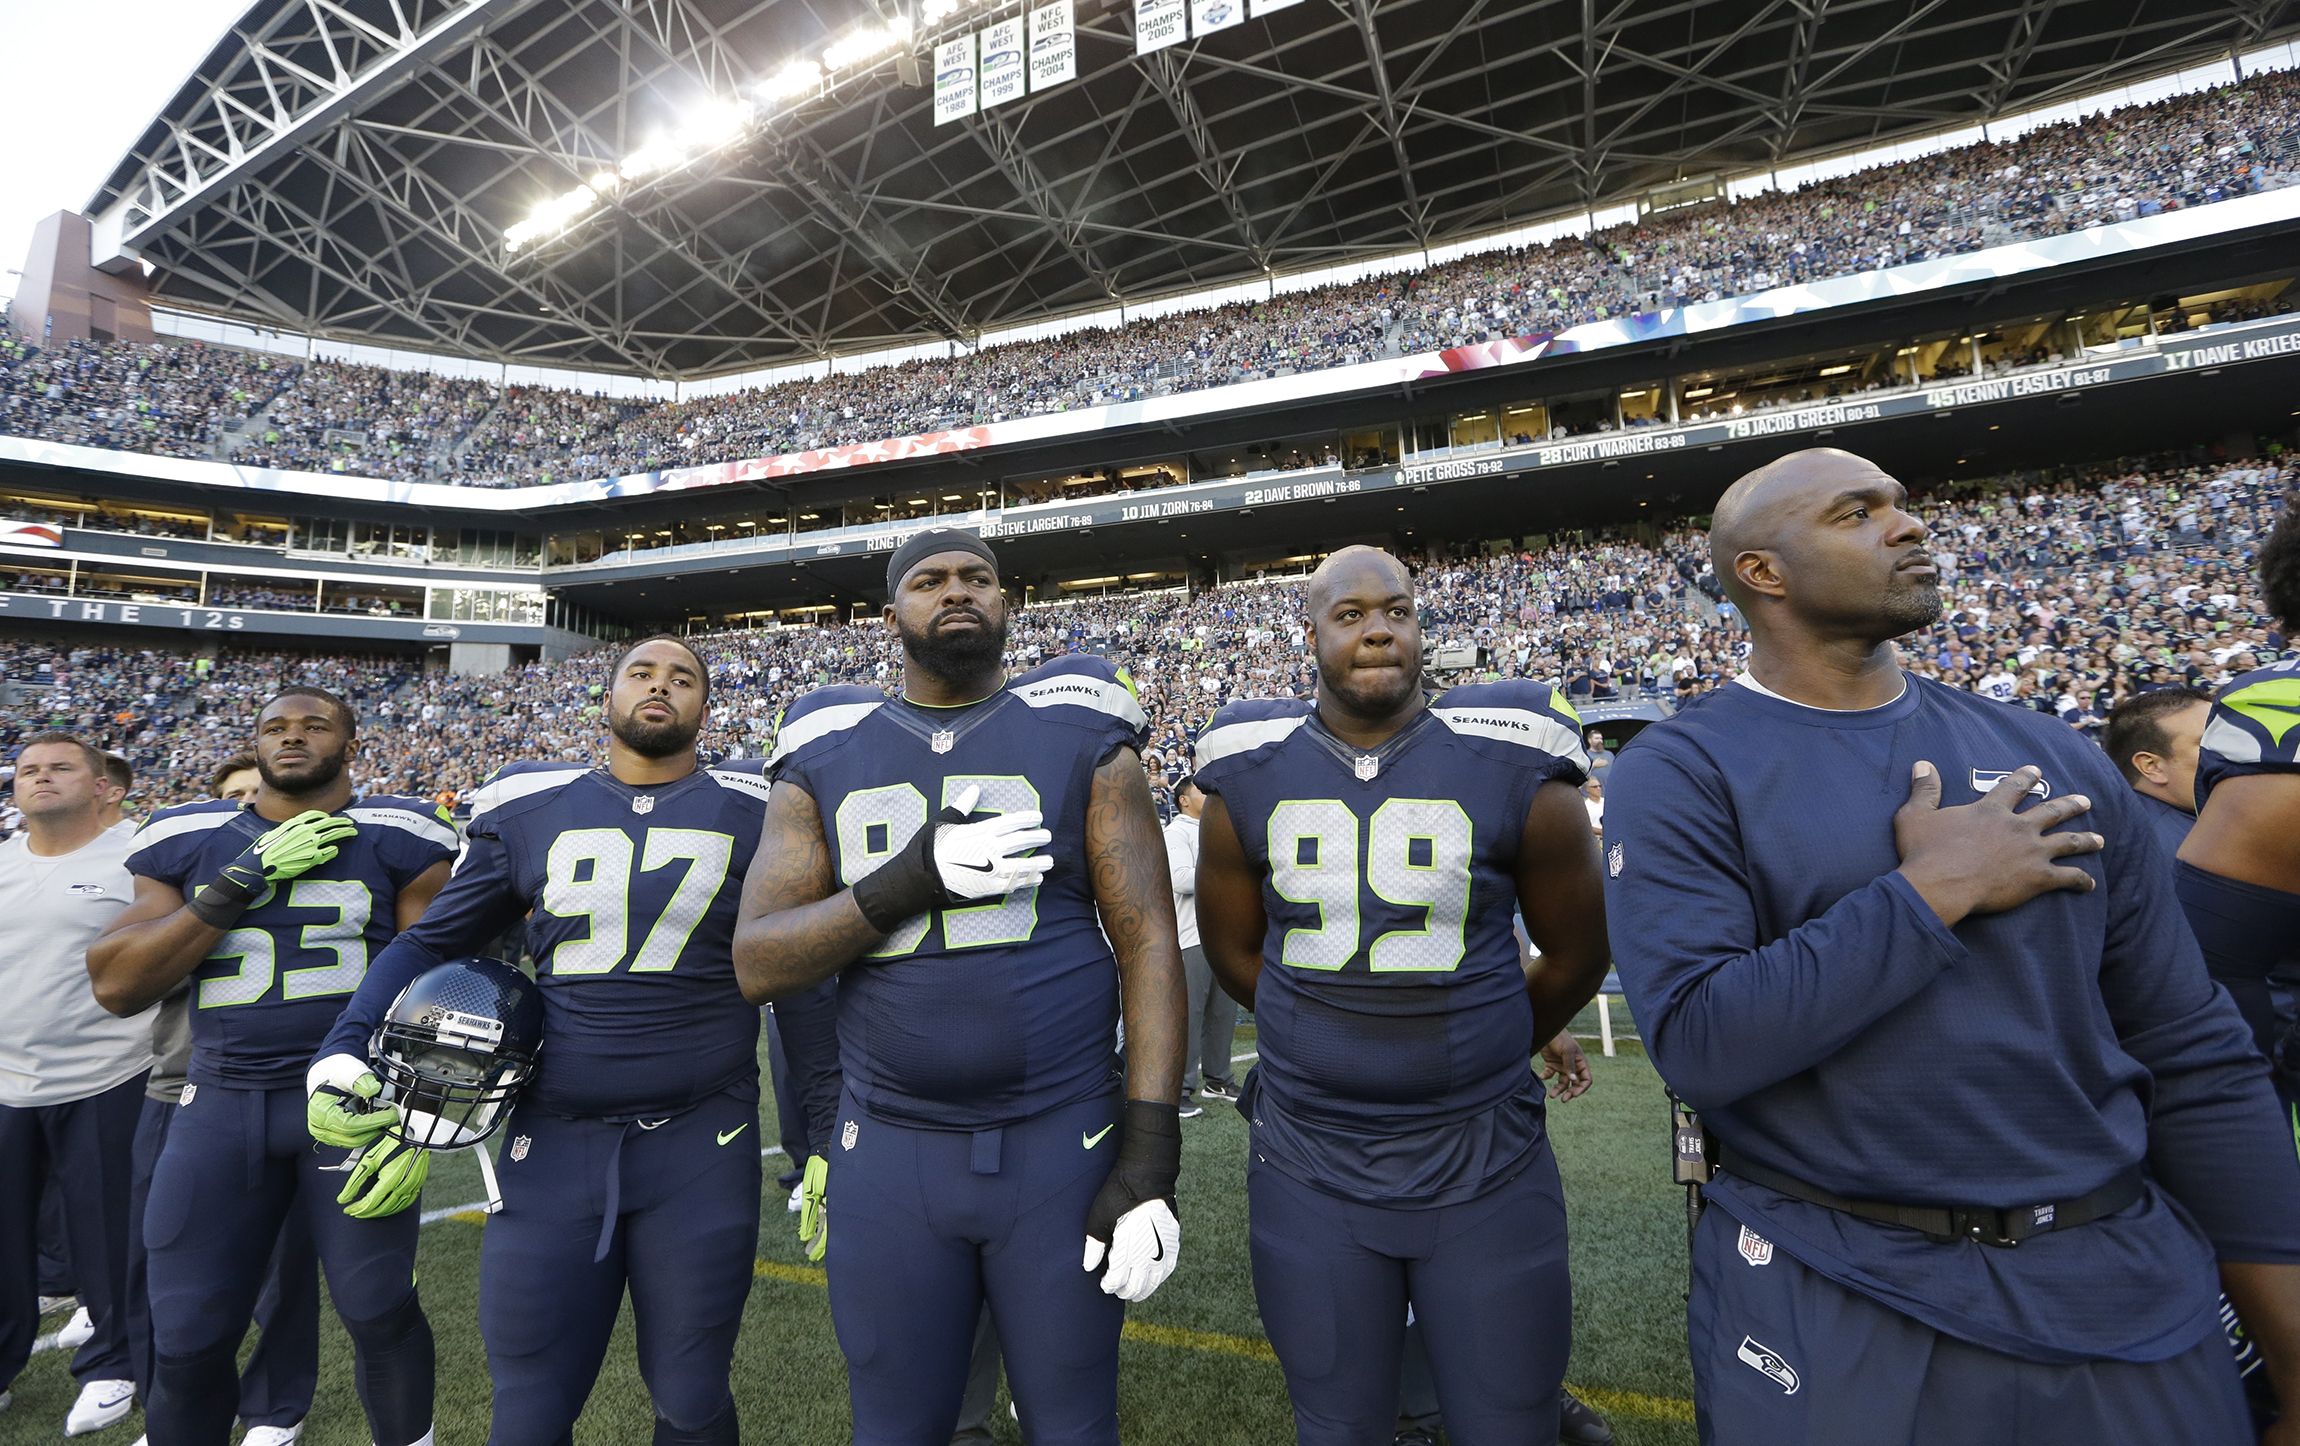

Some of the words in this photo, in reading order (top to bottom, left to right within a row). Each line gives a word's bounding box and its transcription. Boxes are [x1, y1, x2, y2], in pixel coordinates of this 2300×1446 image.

[1040, 6, 1062, 22] NFC
[1138, 9, 1183, 33] CHAMPS
[993, 25, 1011, 39] AFC
[1037, 15, 1065, 33] WEST
[1147, 23, 1175, 41] 2005
[946, 42, 964, 56] AFC
[989, 33, 1015, 50] WEST
[942, 51, 967, 68] WEST
[1032, 48, 1073, 71] CHAMPS
[983, 68, 1022, 90] CHAMPS
[1040, 62, 1065, 79] 2004
[936, 86, 974, 107] CHAMPS
[991, 82, 1014, 98] 1999
[945, 99, 966, 114] 1988
[2163, 350, 2192, 371] 17
[2193, 343, 2242, 367] DAVE
[2243, 333, 2300, 358] KRIEG
[1926, 389, 1956, 408] 45
[1956, 381, 2012, 405] KENNY
[2013, 371, 2072, 396] EASLEY
[1725, 422, 1751, 439] 79
[1751, 414, 1796, 436] JACOB
[1797, 406, 1846, 429] GREEN
[1846, 404, 1881, 422] 80-91
[1539, 450, 1563, 466] 28
[1563, 444, 1597, 464] CURT
[1598, 436, 1654, 458] WARNER
[1654, 435, 1686, 450] 83-89
[1405, 466, 1435, 484] PETE
[1436, 461, 1476, 480] GROSS
[1476, 460, 1504, 475] 79-92
[1244, 490, 1264, 505] 22
[1264, 486, 1291, 502] DAVE
[1293, 481, 1335, 499] BROWN
[1335, 479, 1361, 493] 76-86
[1121, 507, 1138, 521] 10
[1139, 503, 1160, 519] JIM
[1161, 500, 1189, 516] ZORN
[1189, 499, 1214, 512] 76-84
[979, 525, 997, 539] 80
[997, 520, 1026, 536] STEVE
[1026, 514, 1070, 532] LARGENT
[1070, 514, 1093, 528] 76-89
[867, 533, 894, 551] RING
[48, 600, 141, 623] THE
[180, 610, 244, 629] 12s
[1029, 685, 1101, 698] SEAHAWKS
[1452, 715, 1530, 732] SEAHAWKS
[720, 775, 770, 791] SEAHAW
[371, 812, 418, 825] SEAHAWKS
[1267, 797, 1474, 972] 99
[543, 826, 736, 976] 97
[194, 879, 373, 1010] 53
[457, 1015, 492, 1030] SEAHAWKS
[2034, 1204, 2054, 1217] TRAVIS
[2035, 1213, 2053, 1225] JONES
[1743, 1237, 1766, 1258] NFL
